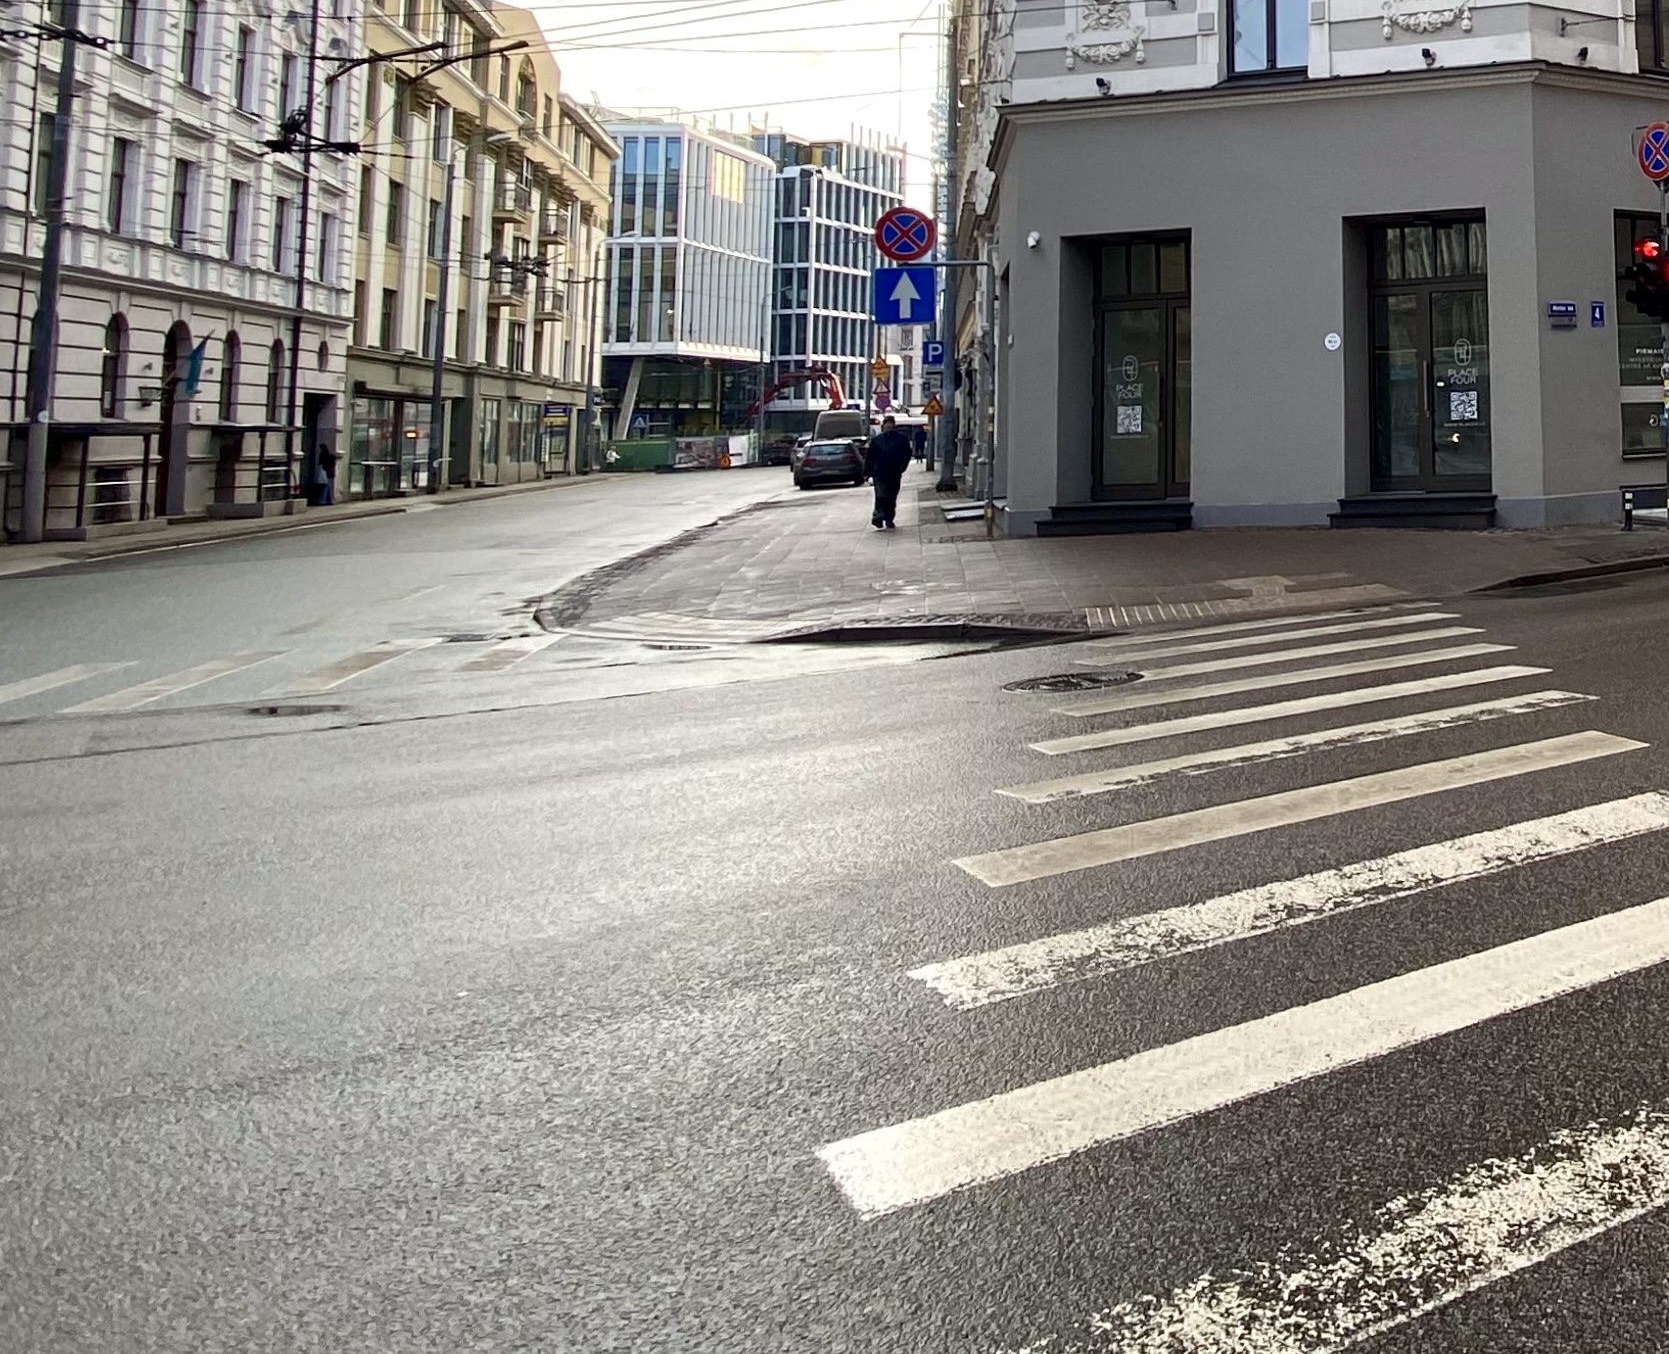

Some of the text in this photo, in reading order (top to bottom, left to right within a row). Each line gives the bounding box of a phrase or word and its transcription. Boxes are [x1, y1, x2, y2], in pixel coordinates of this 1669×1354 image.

[928, 343, 943, 362] P
[1447, 367, 1479, 377] PLACE
[1450, 376, 1477, 385] FOUR
